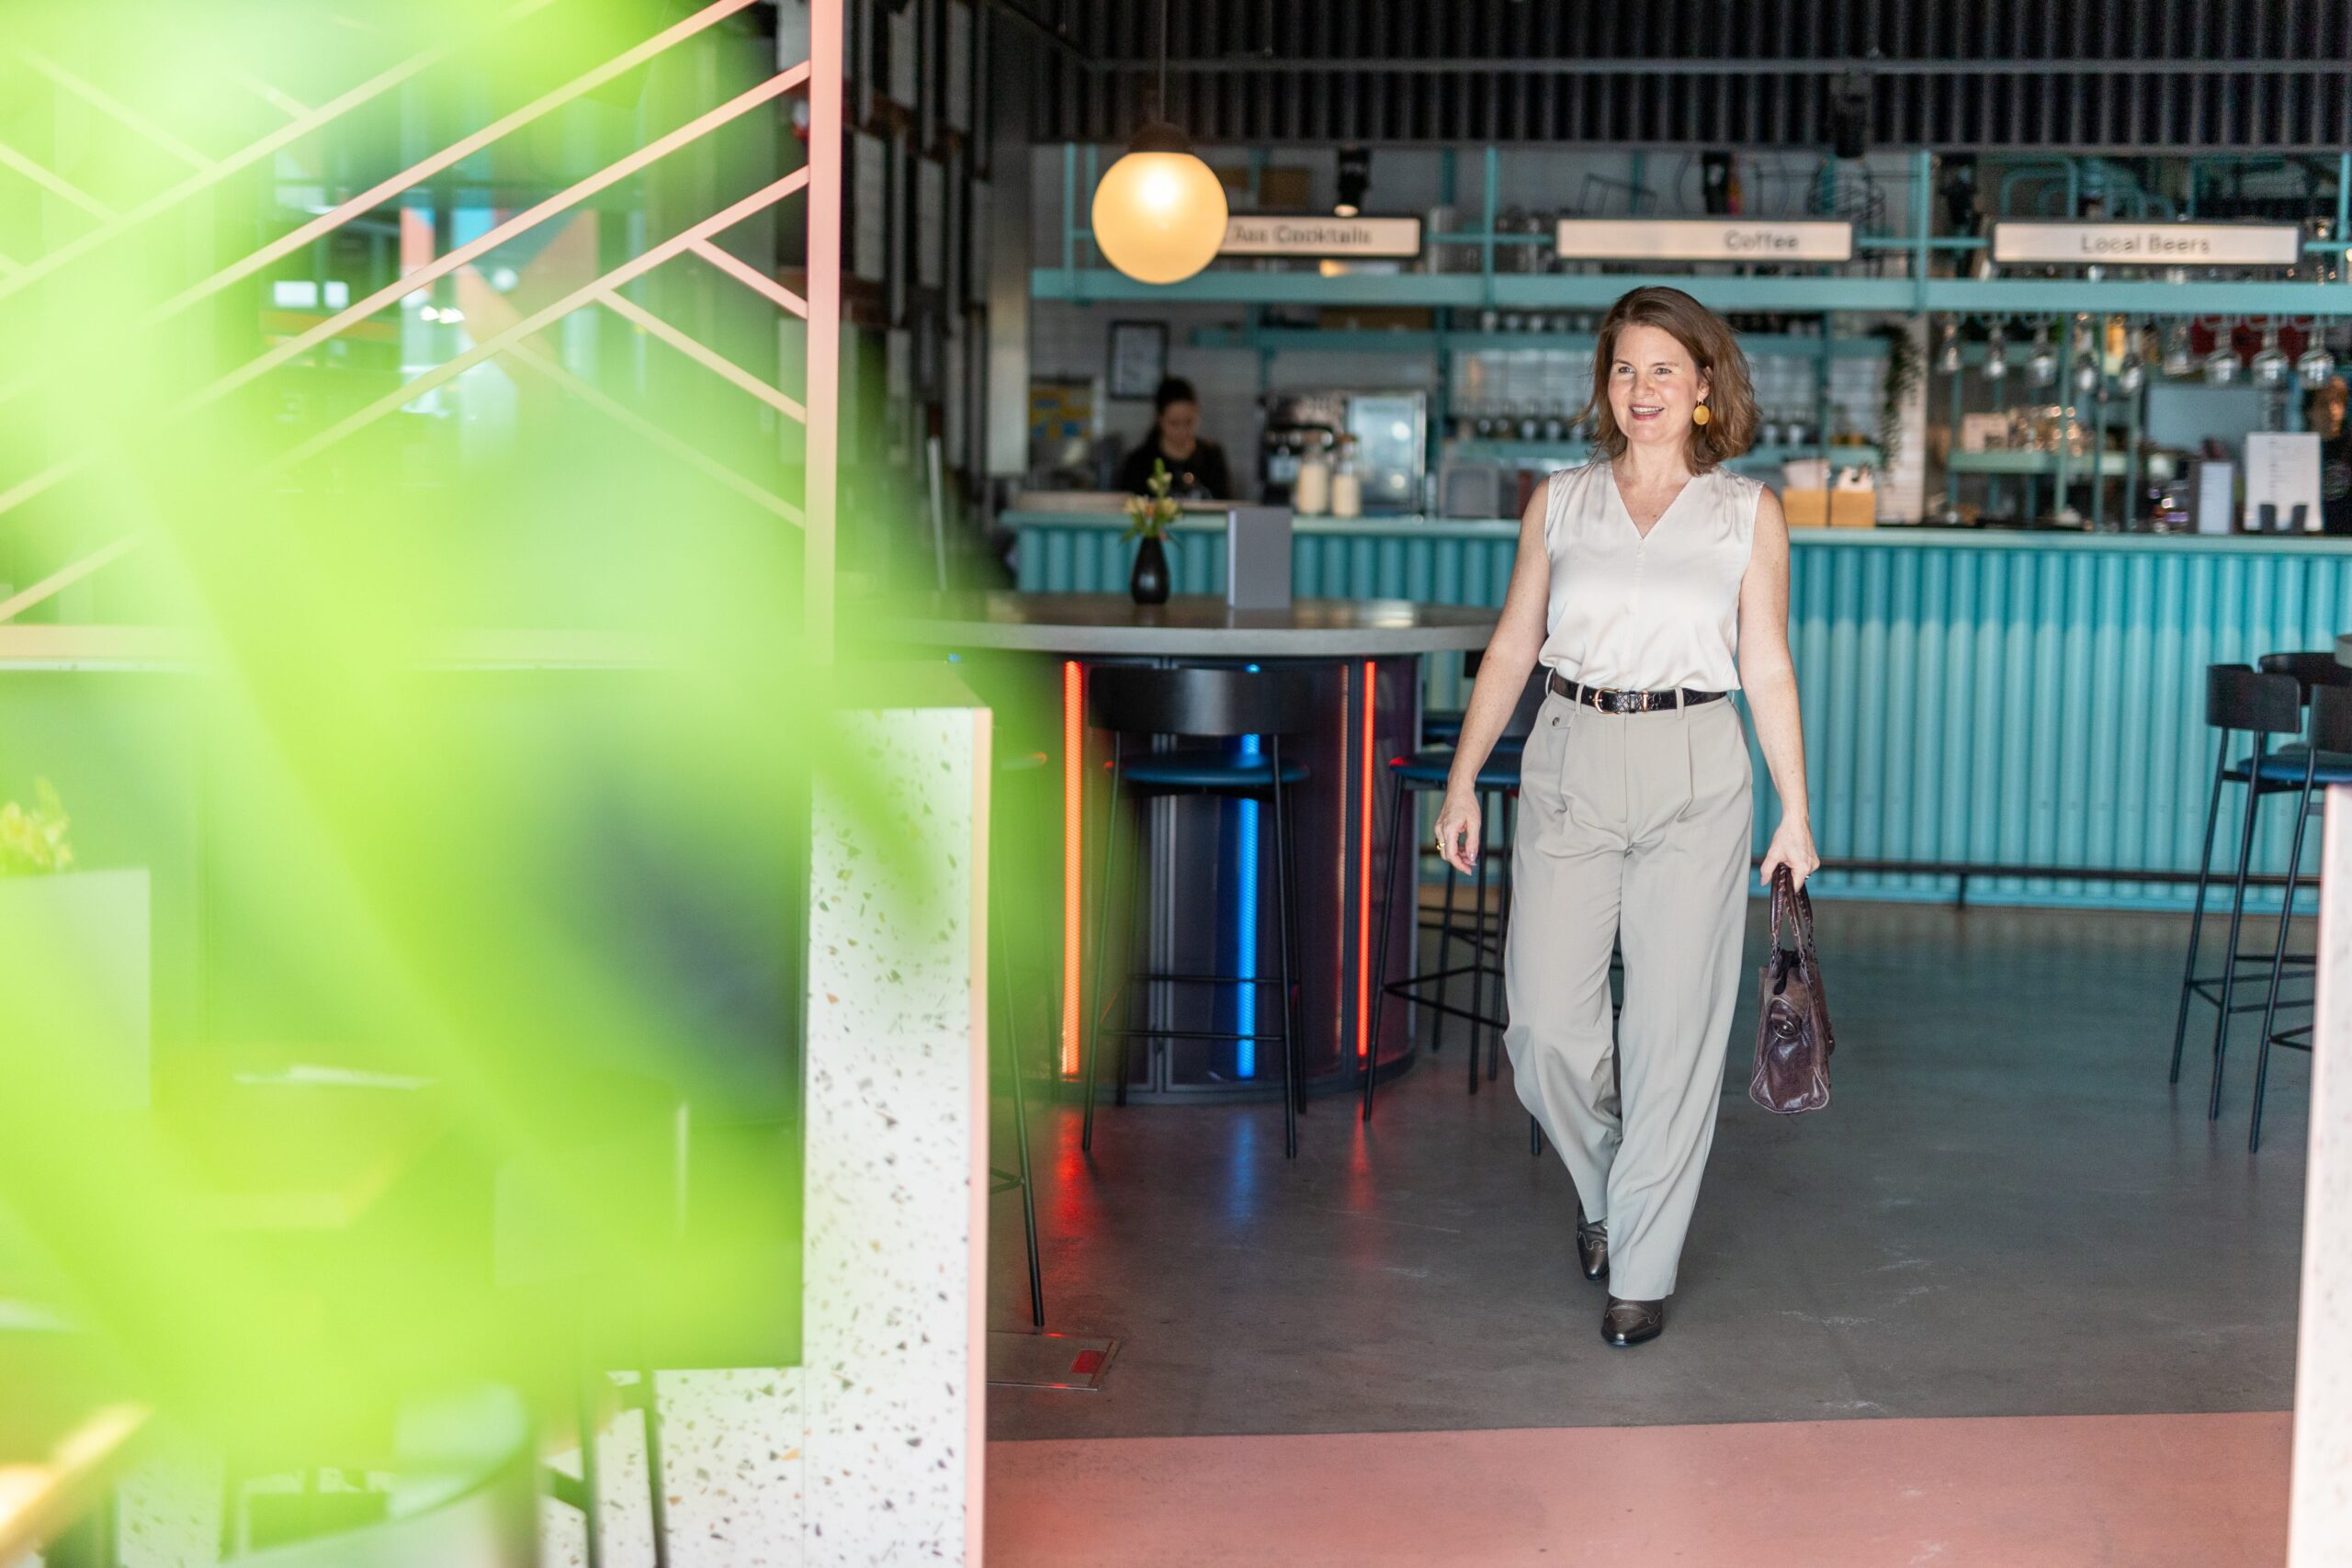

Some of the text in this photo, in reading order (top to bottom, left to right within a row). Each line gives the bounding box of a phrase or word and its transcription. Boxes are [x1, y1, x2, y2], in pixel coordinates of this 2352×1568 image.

[1273, 225, 1373, 244] Cocktails
[1724, 230, 1799, 251] Coffee
[2080, 233, 2211, 254] Local Beers
